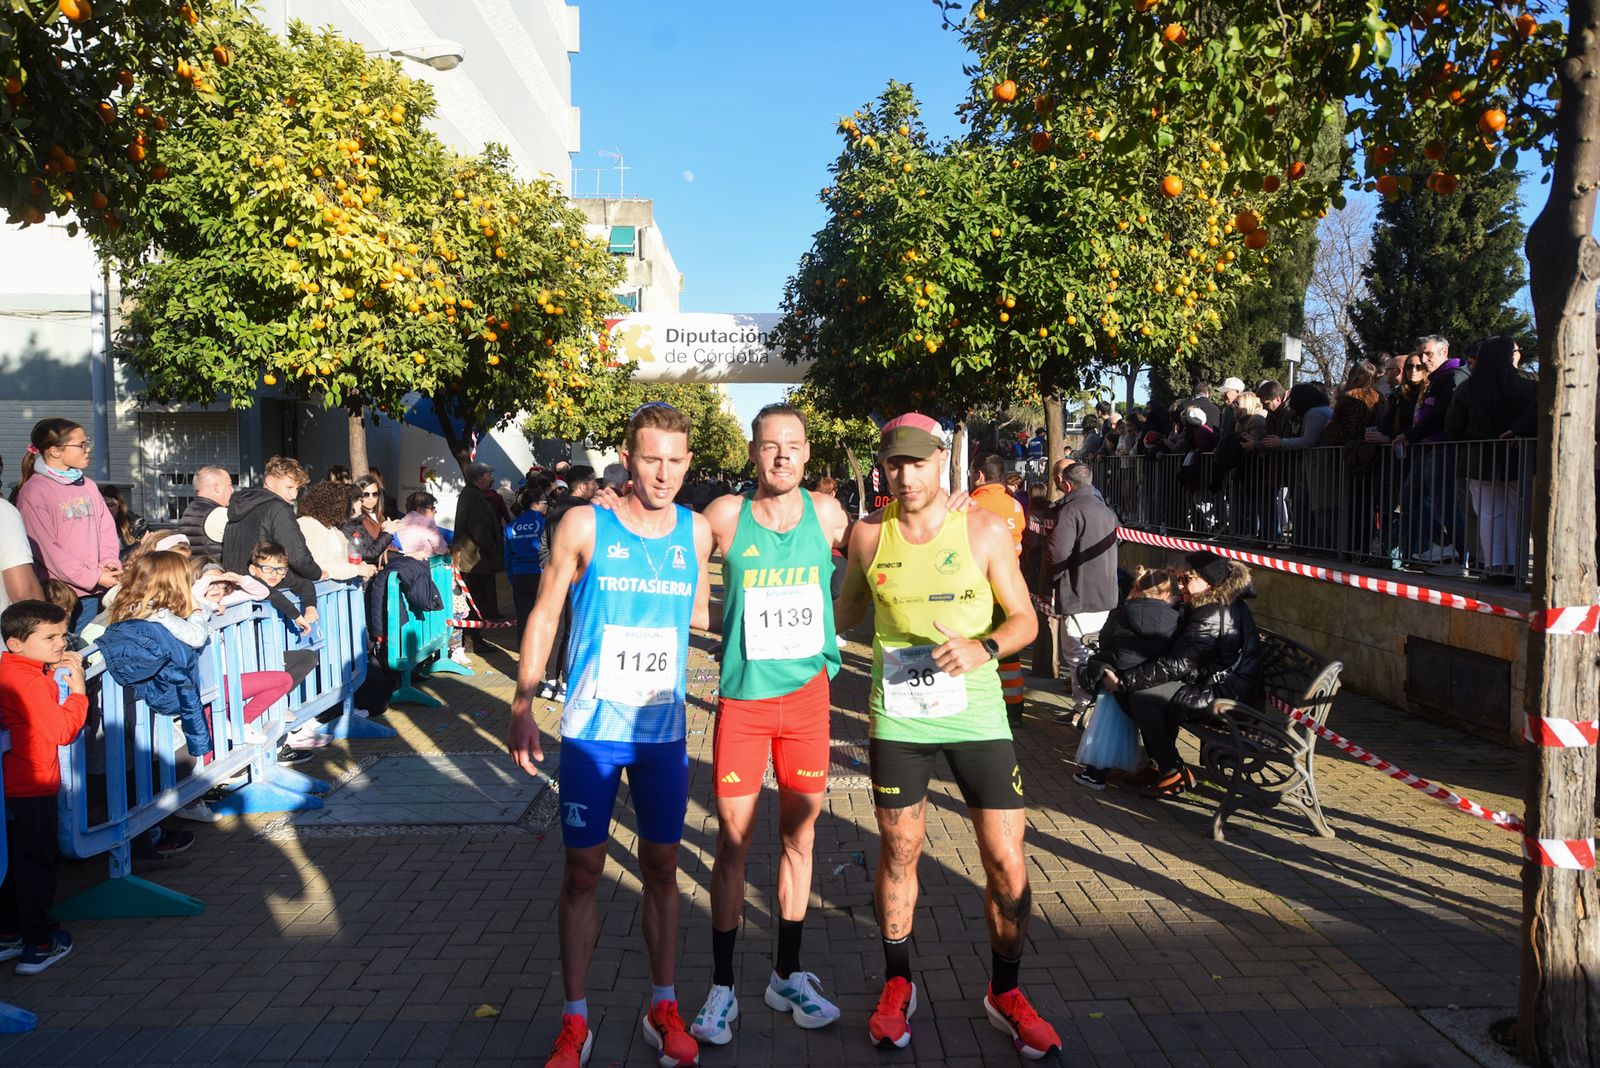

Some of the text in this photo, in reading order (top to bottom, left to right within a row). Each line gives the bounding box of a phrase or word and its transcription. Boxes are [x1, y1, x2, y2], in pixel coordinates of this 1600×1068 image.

[666, 328, 768, 346] Diputación
[665, 346, 769, 364] de Córdoba
[597, 576, 692, 597] TROTASIERRA
[743, 566, 820, 588] BIKILA
[759, 607, 813, 628] 1139
[616, 650, 668, 672] 1126
[908, 667, 935, 687] 36
[797, 769, 824, 778] BIKILA
